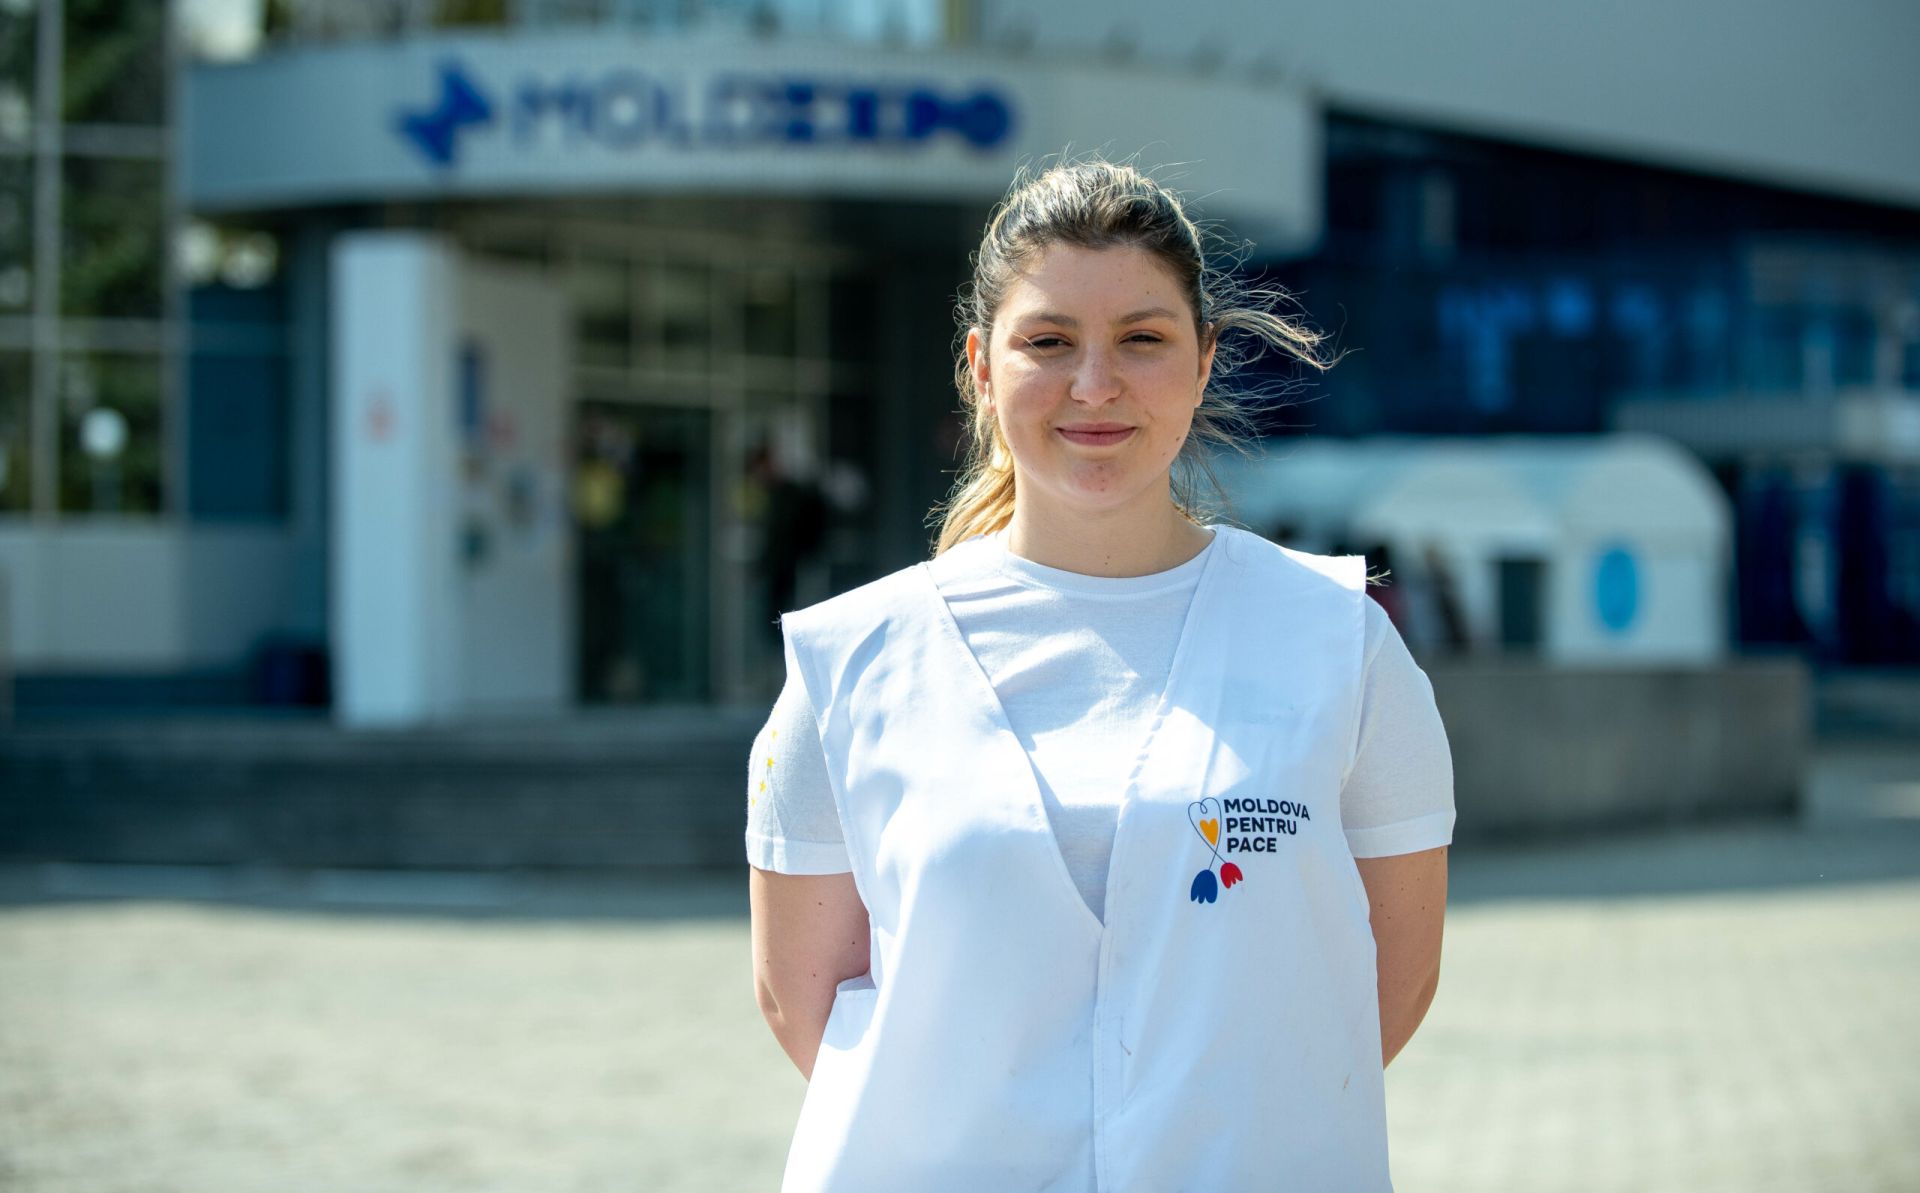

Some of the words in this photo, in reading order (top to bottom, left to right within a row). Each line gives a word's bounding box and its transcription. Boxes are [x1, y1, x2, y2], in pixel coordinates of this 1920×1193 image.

[1224, 798, 1310, 821] MOLDOVA
[1226, 817, 1297, 835] PENTRU
[1227, 837, 1277, 853] PACE
